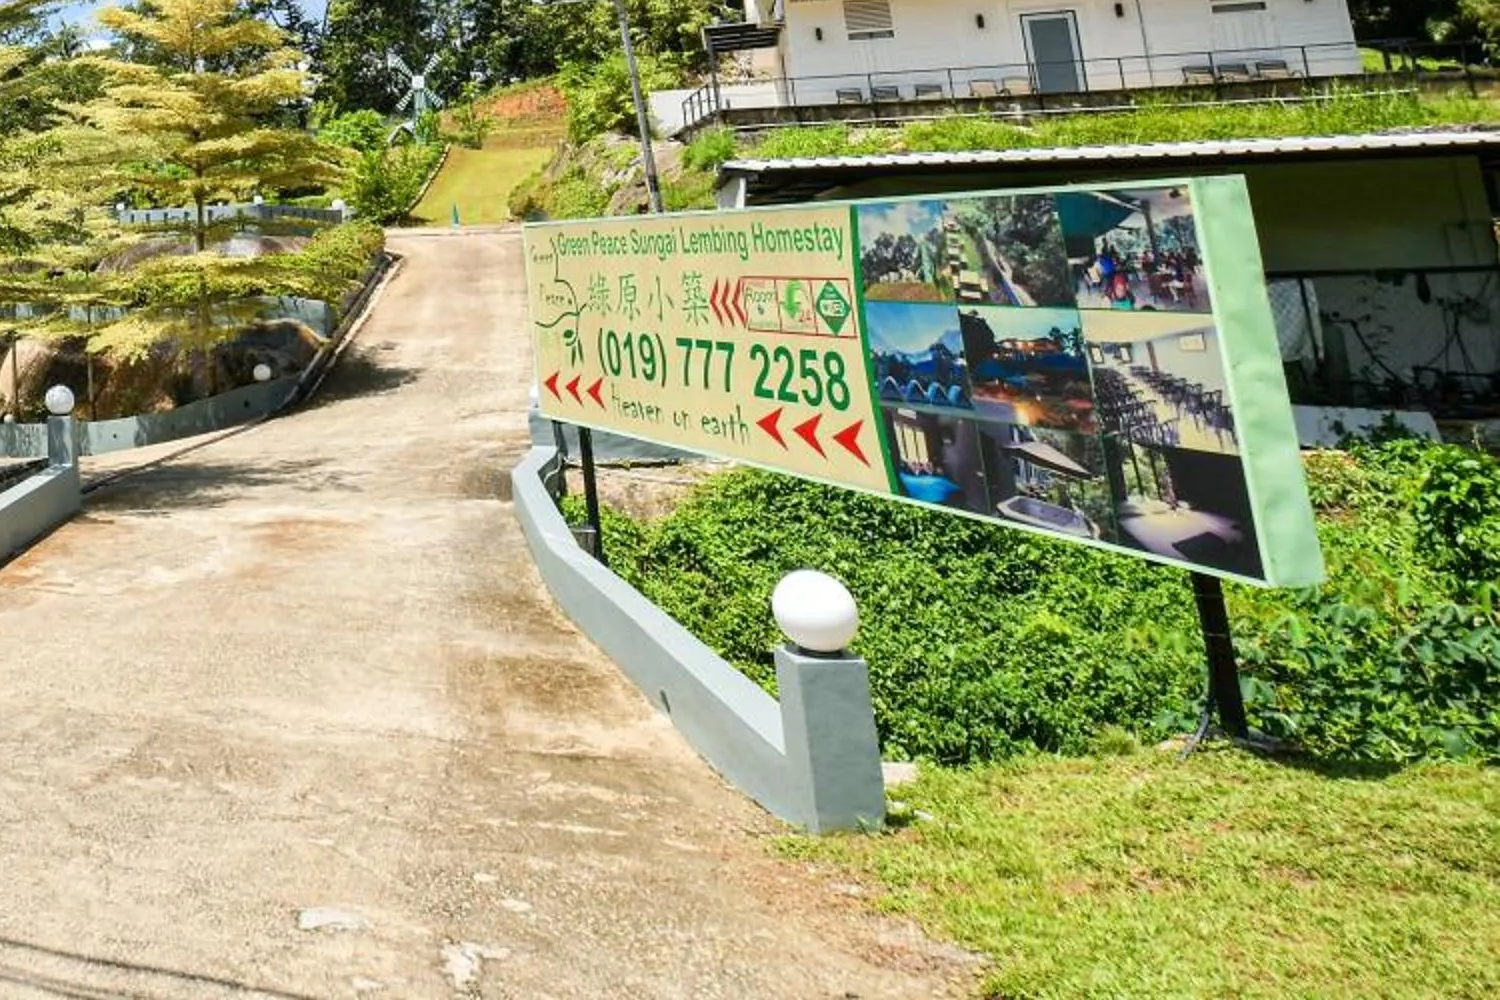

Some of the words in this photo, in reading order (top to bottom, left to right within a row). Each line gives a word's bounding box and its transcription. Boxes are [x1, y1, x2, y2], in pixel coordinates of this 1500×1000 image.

[557, 231, 589, 256] Green
[591, 229, 627, 255] Peace
[629, 226, 676, 261] Sungai
[679, 225, 748, 261] Lembing
[751, 221, 843, 261] Homestay
[597, 327, 667, 389] (019)
[675, 337, 735, 393] 777
[749, 343, 850, 411] 2258
[701, 403, 750, 446] earth
